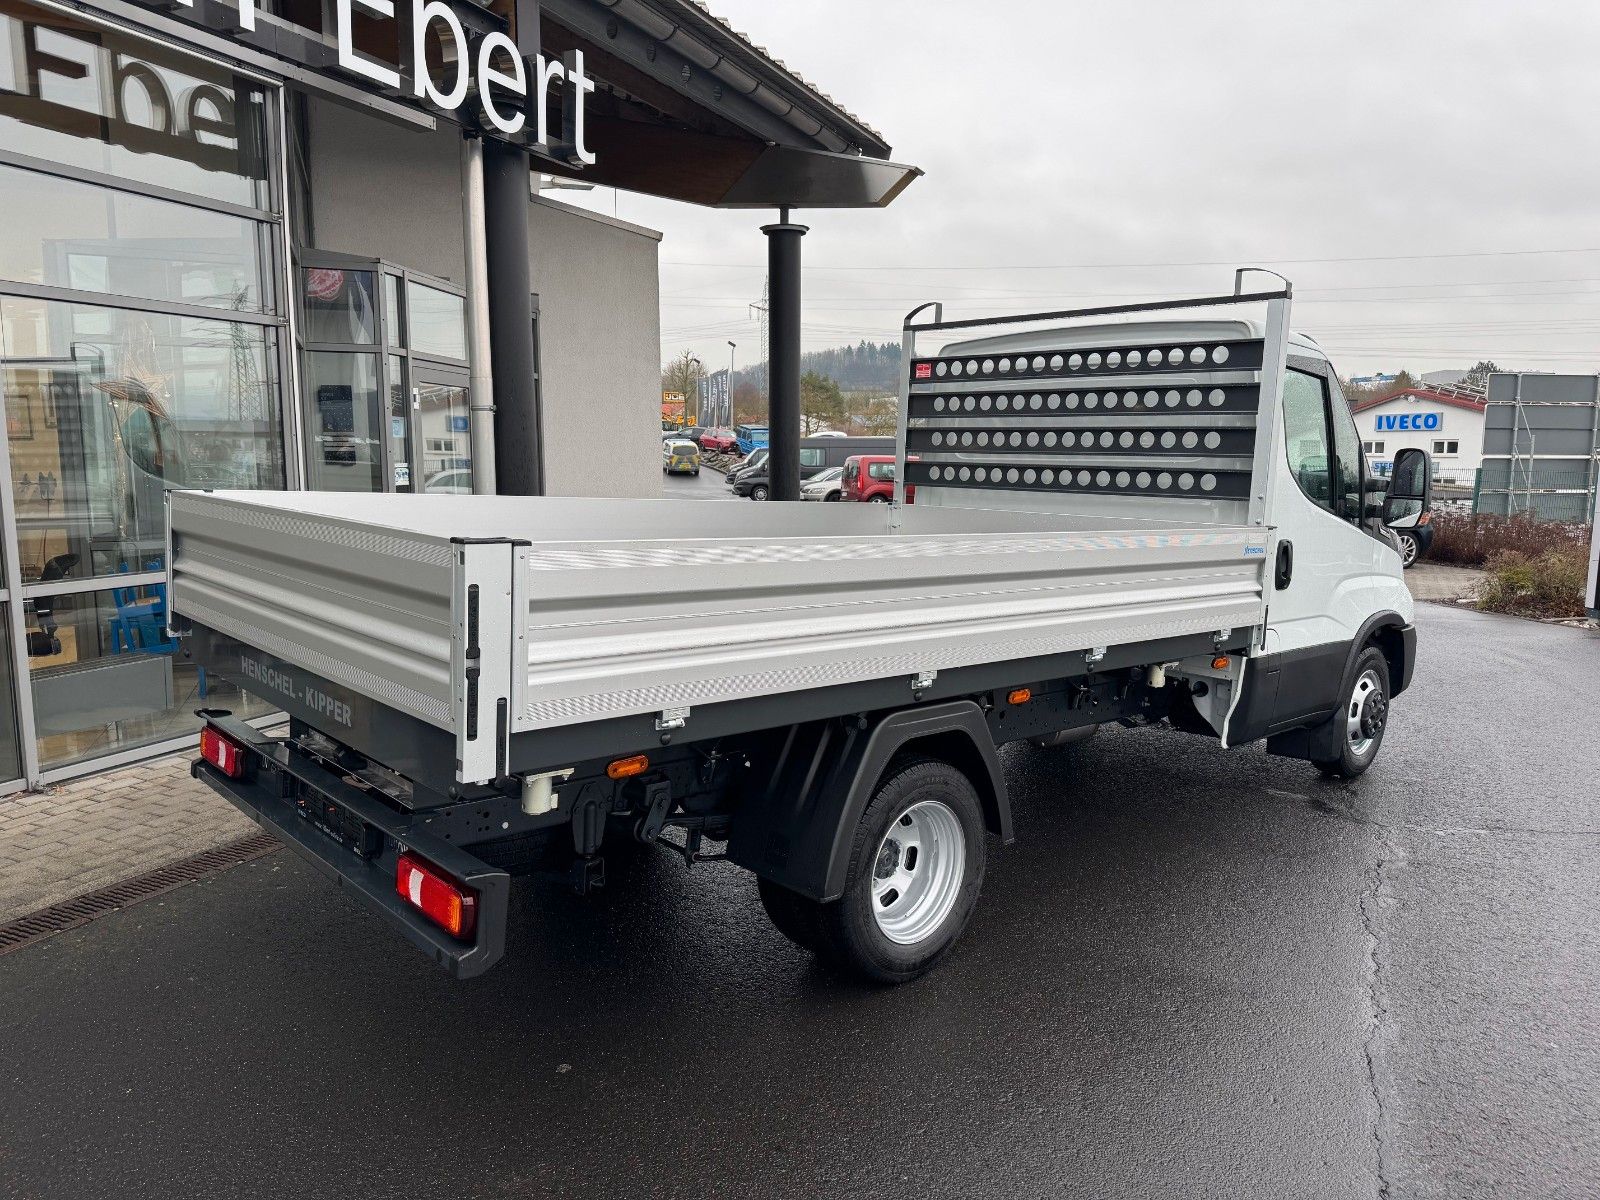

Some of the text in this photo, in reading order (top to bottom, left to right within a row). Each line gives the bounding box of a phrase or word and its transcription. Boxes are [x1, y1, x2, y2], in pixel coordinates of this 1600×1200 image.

[338, 0, 596, 164] Ebert
[1377, 413, 1438, 430] IVECO
[241, 655, 296, 699] HENSCHEL
[305, 686, 352, 728] KIPPER
